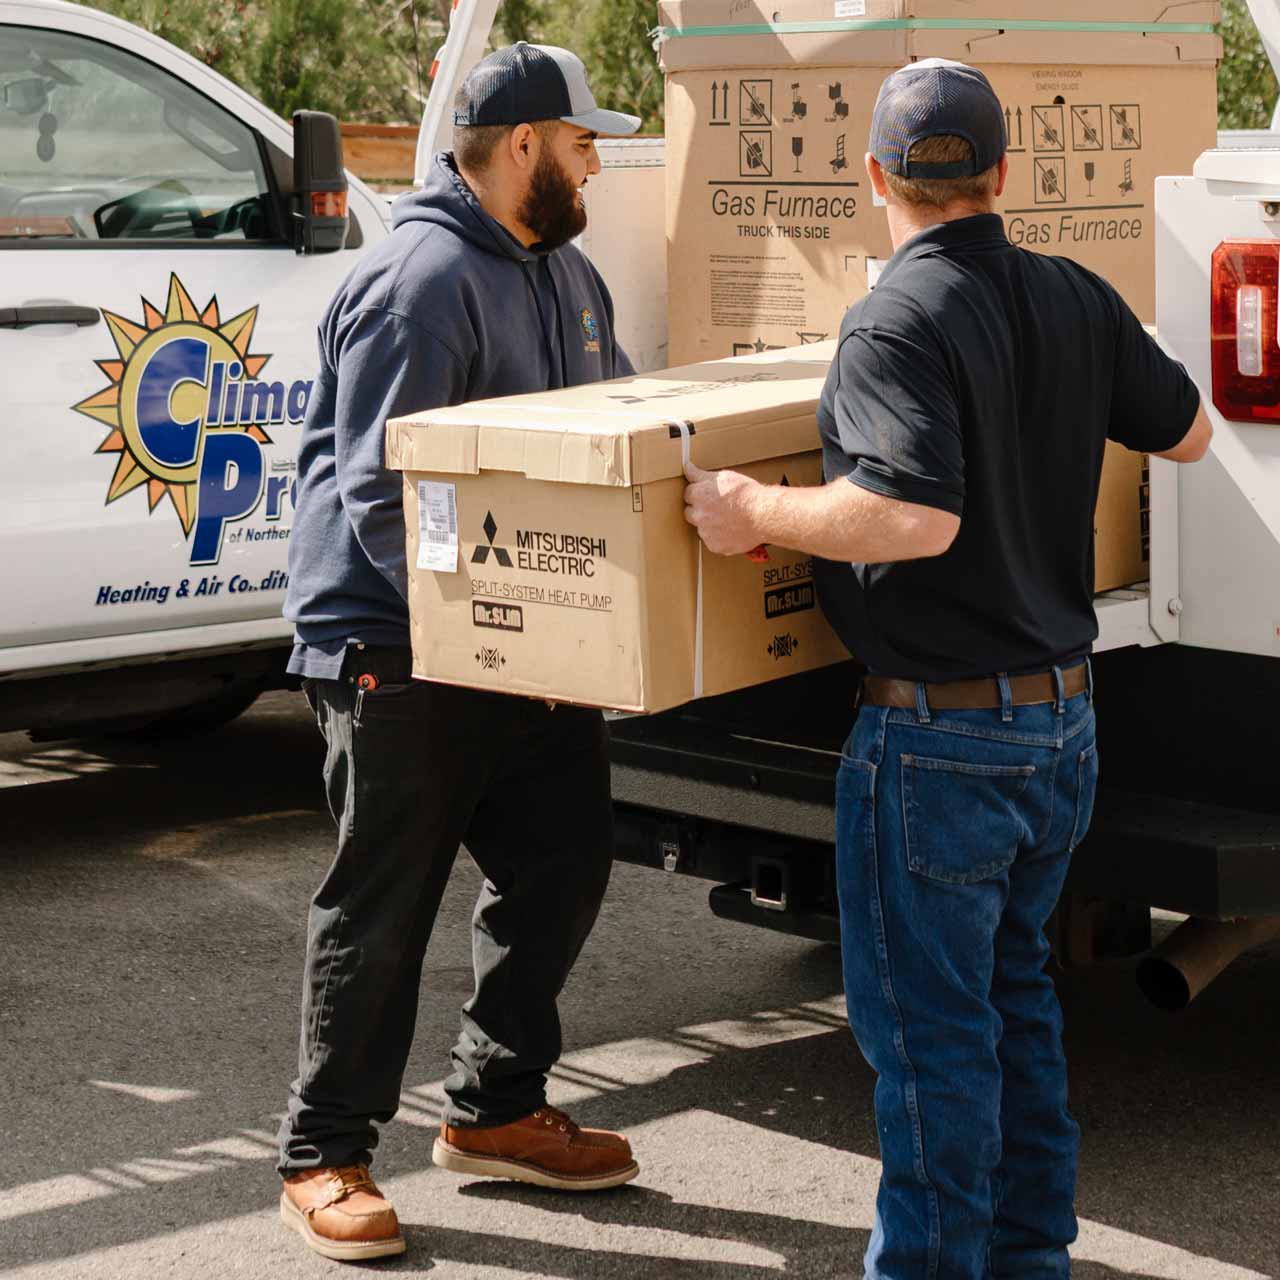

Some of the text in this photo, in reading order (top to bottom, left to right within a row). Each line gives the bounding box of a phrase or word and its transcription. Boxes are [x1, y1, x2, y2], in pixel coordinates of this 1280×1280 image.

[712, 189, 856, 218] Gas Furnace
[737, 225, 830, 239] TRUCK THIS SIDE
[1008, 215, 1142, 245] Gas Furnace
[136, 336, 316, 469] Clima
[190, 431, 298, 566] Pr
[245, 525, 291, 543] Norther
[516, 530, 607, 558] MITSUBISHI
[517, 551, 596, 577] ELECTRIC
[763, 560, 814, 584] SPLIT-SYS
[95, 580, 171, 606] Heating
[176, 579, 190, 598] &
[195, 576, 223, 597] Air
[471, 578, 613, 609] SPLIT-SYSTEM HEAT PUMP
